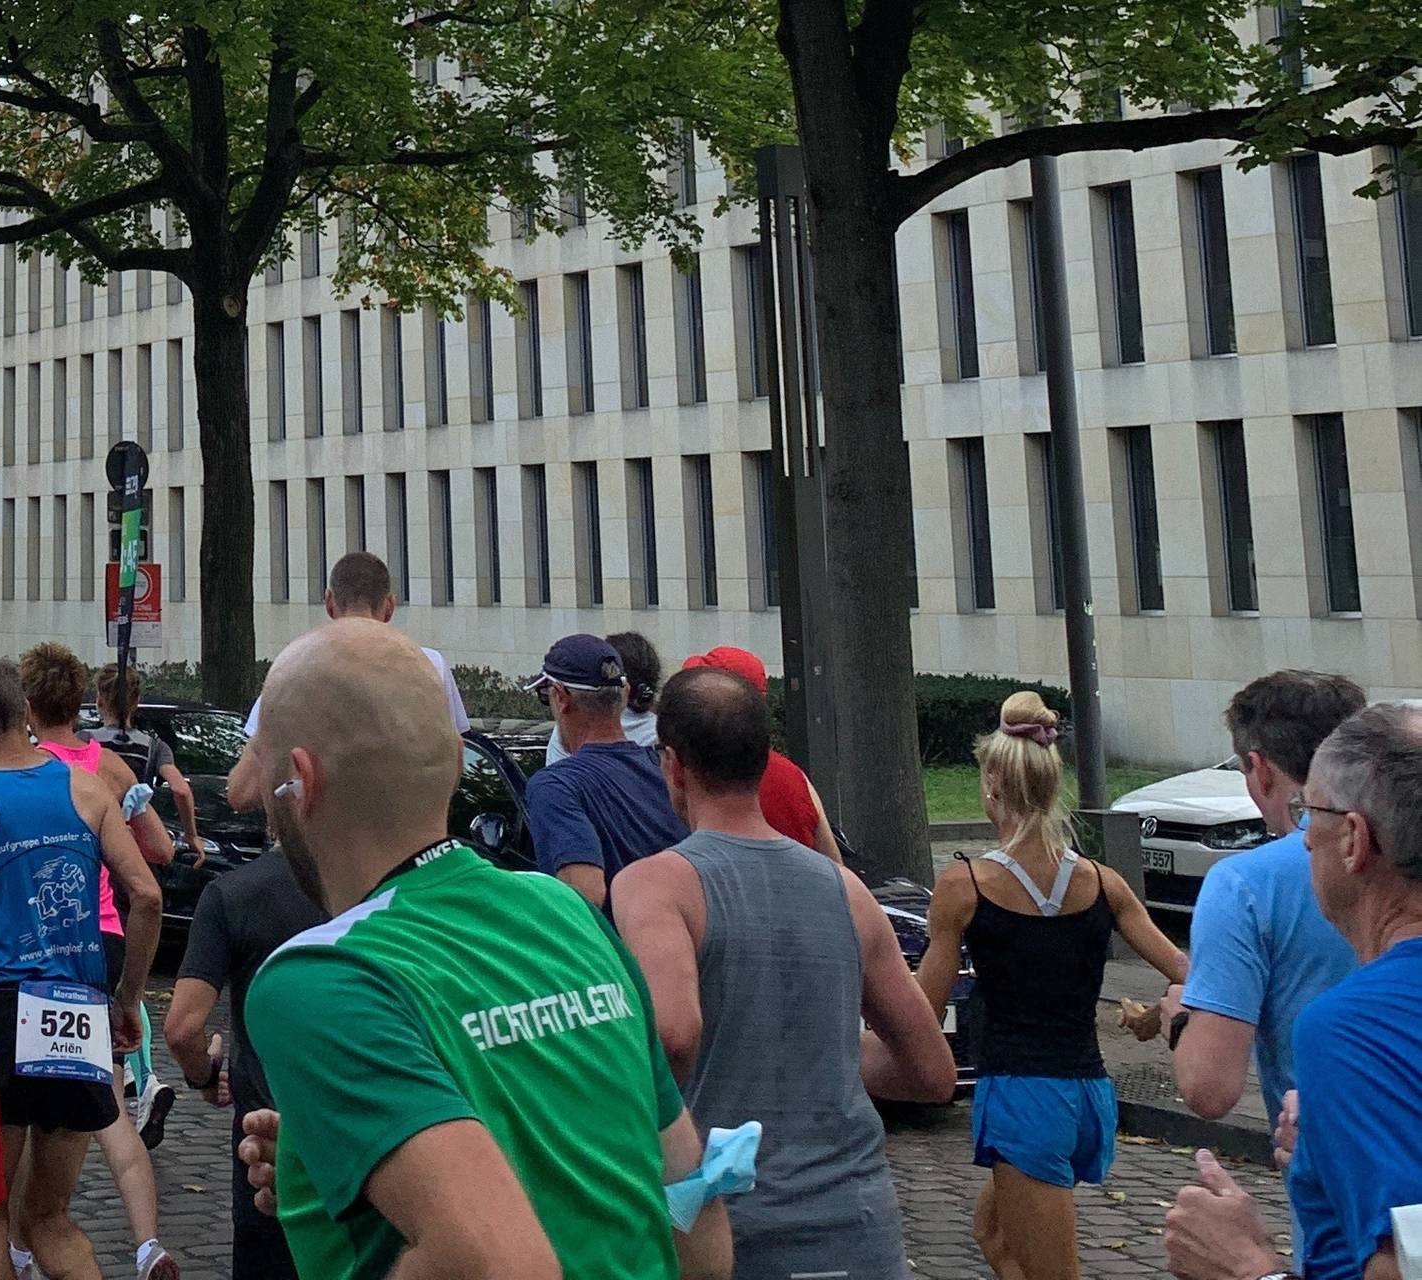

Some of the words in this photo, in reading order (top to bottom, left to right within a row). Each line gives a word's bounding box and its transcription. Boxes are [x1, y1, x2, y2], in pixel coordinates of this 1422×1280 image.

[42, 832, 80, 845] Dasseler
[1152, 852, 1171, 868] 557
[52, 989, 88, 1001] Marathon
[40, 1009, 92, 1041] 526
[50, 1041, 83, 1054] Ariën
